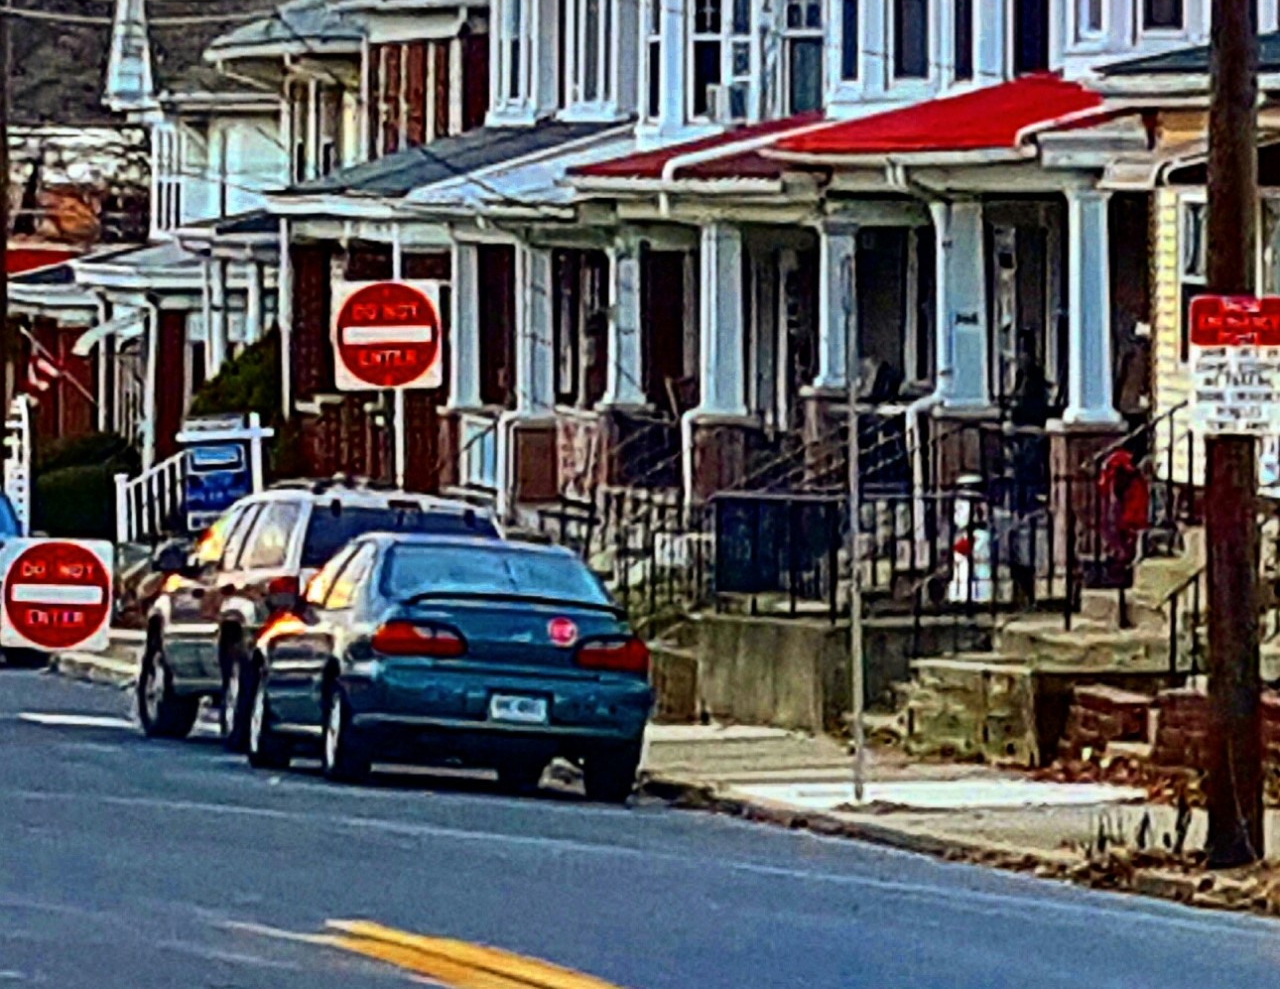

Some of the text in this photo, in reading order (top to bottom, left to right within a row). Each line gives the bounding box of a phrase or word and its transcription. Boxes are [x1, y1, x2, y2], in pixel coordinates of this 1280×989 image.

[352, 302, 418, 320] DO NOT
[358, 350, 417, 367] ENTER
[22, 561, 94, 579] DO NOT
